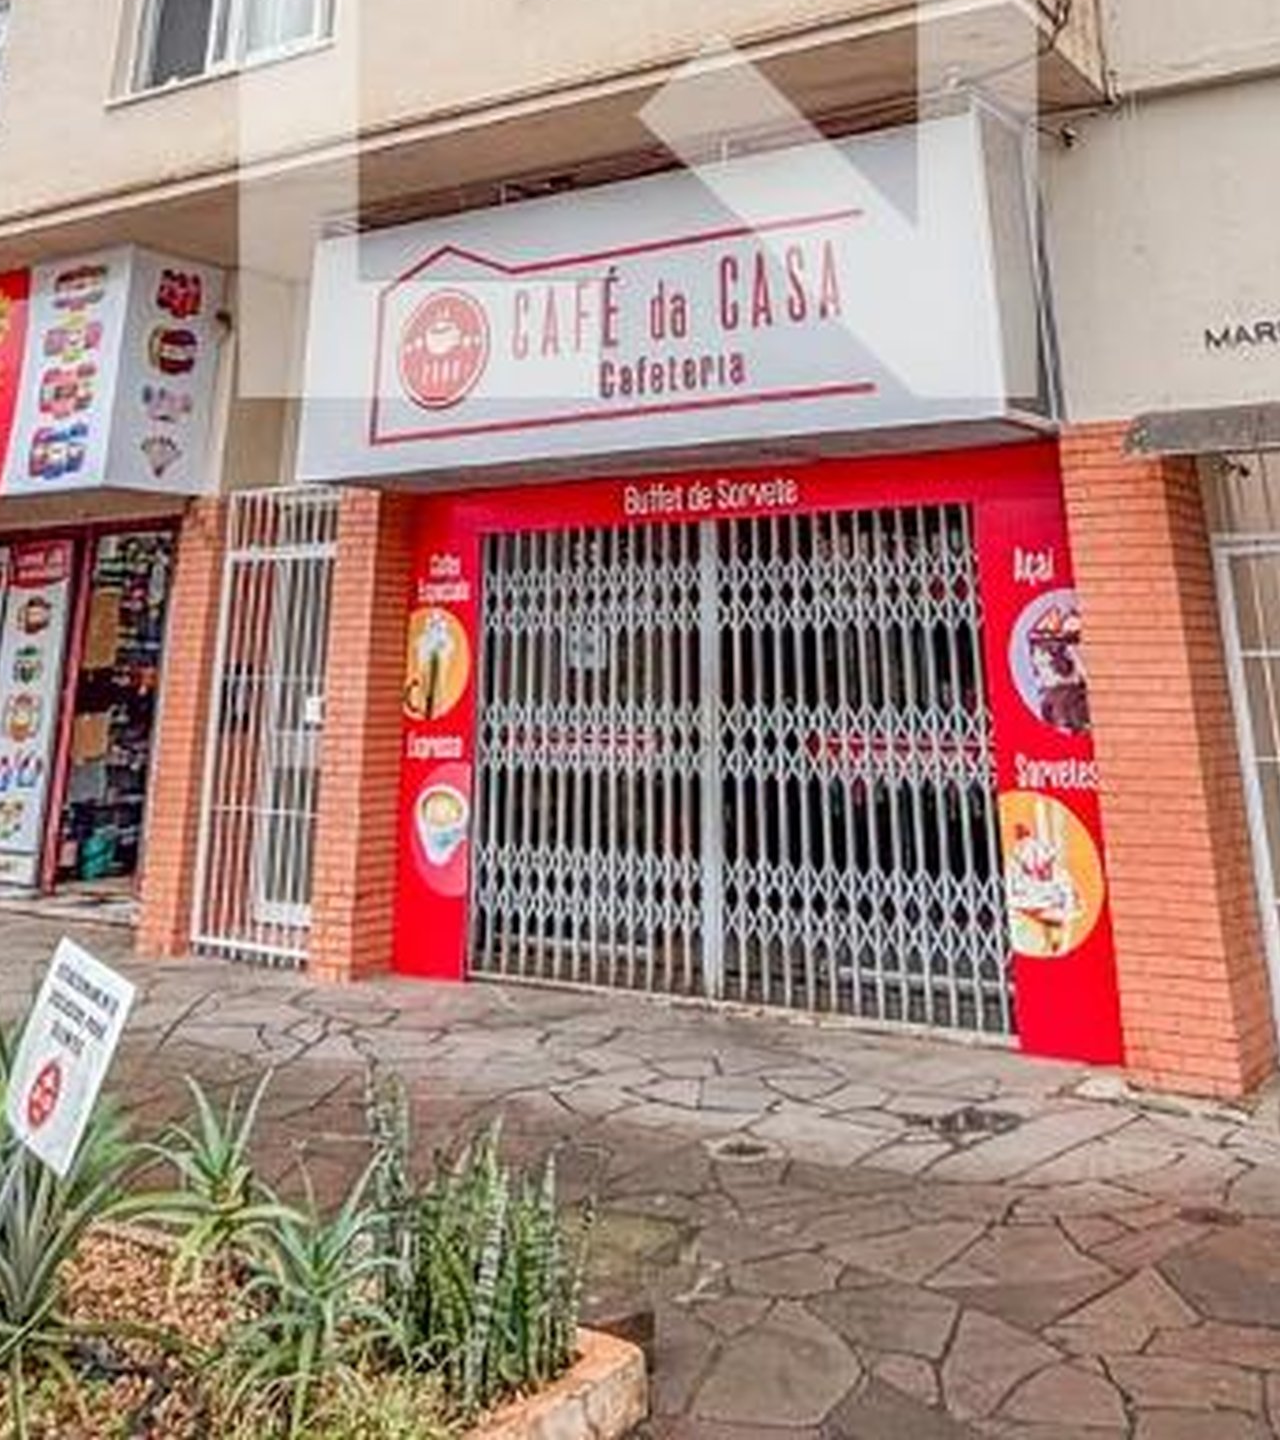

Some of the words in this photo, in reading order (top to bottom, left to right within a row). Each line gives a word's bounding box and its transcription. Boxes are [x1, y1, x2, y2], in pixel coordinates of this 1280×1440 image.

[513, 266, 619, 359] CAFÉ
[650, 279, 686, 339] da
[720, 240, 841, 330] CASA
[600, 352, 745, 398] Cafeteria
[624, 482, 684, 515] Buffet
[687, 480, 712, 510] de
[718, 478, 798, 509] Sorvete
